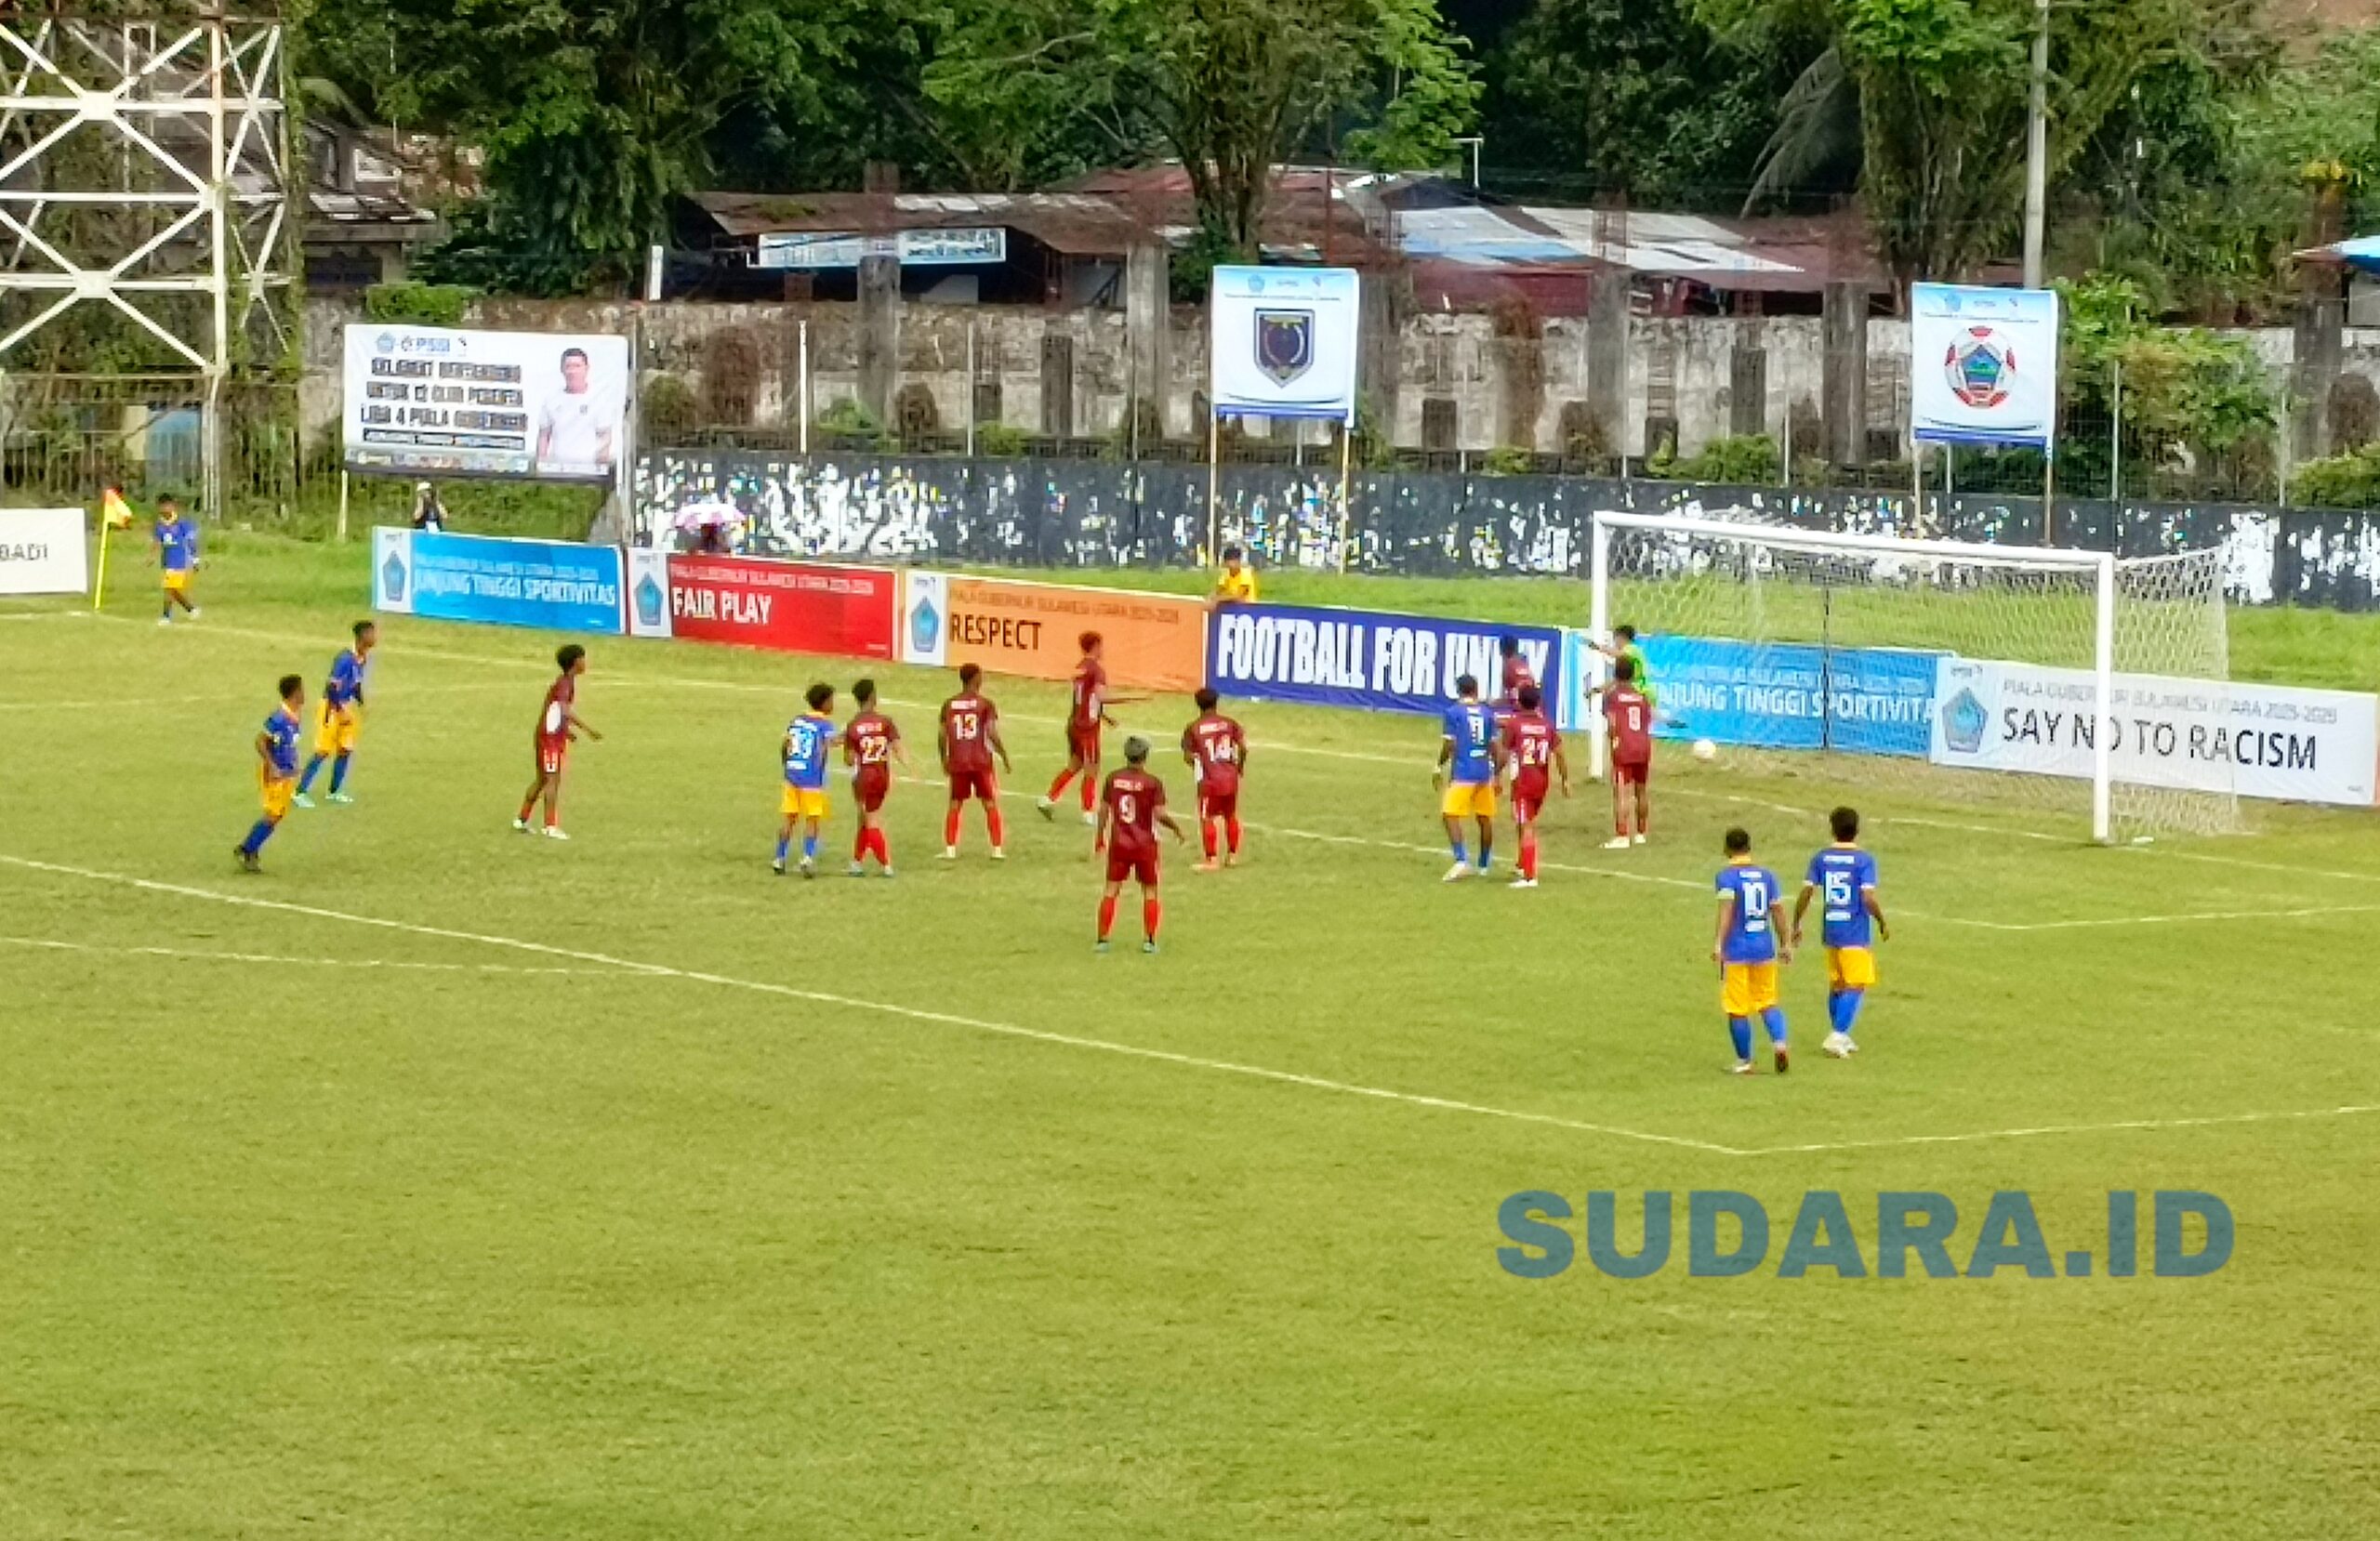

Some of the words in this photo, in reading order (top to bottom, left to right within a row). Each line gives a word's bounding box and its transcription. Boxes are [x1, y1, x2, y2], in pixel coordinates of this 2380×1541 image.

[524, 578, 616, 606] SPORTIVITAS
[672, 586, 718, 621] FAIR
[721, 589, 773, 625] PLAY
[949, 612, 1042, 651] RESPECT
[1217, 613, 1367, 690] FOOTBALL
[1371, 626, 1438, 696] FOR
[1733, 684, 1806, 717] TINGGI
[2003, 706, 2063, 745] SAY
[2133, 719, 2175, 757] TO
[2189, 724, 2316, 771] RACISM
[1741, 881, 1767, 917] 10
[1824, 870, 1853, 907] 15
